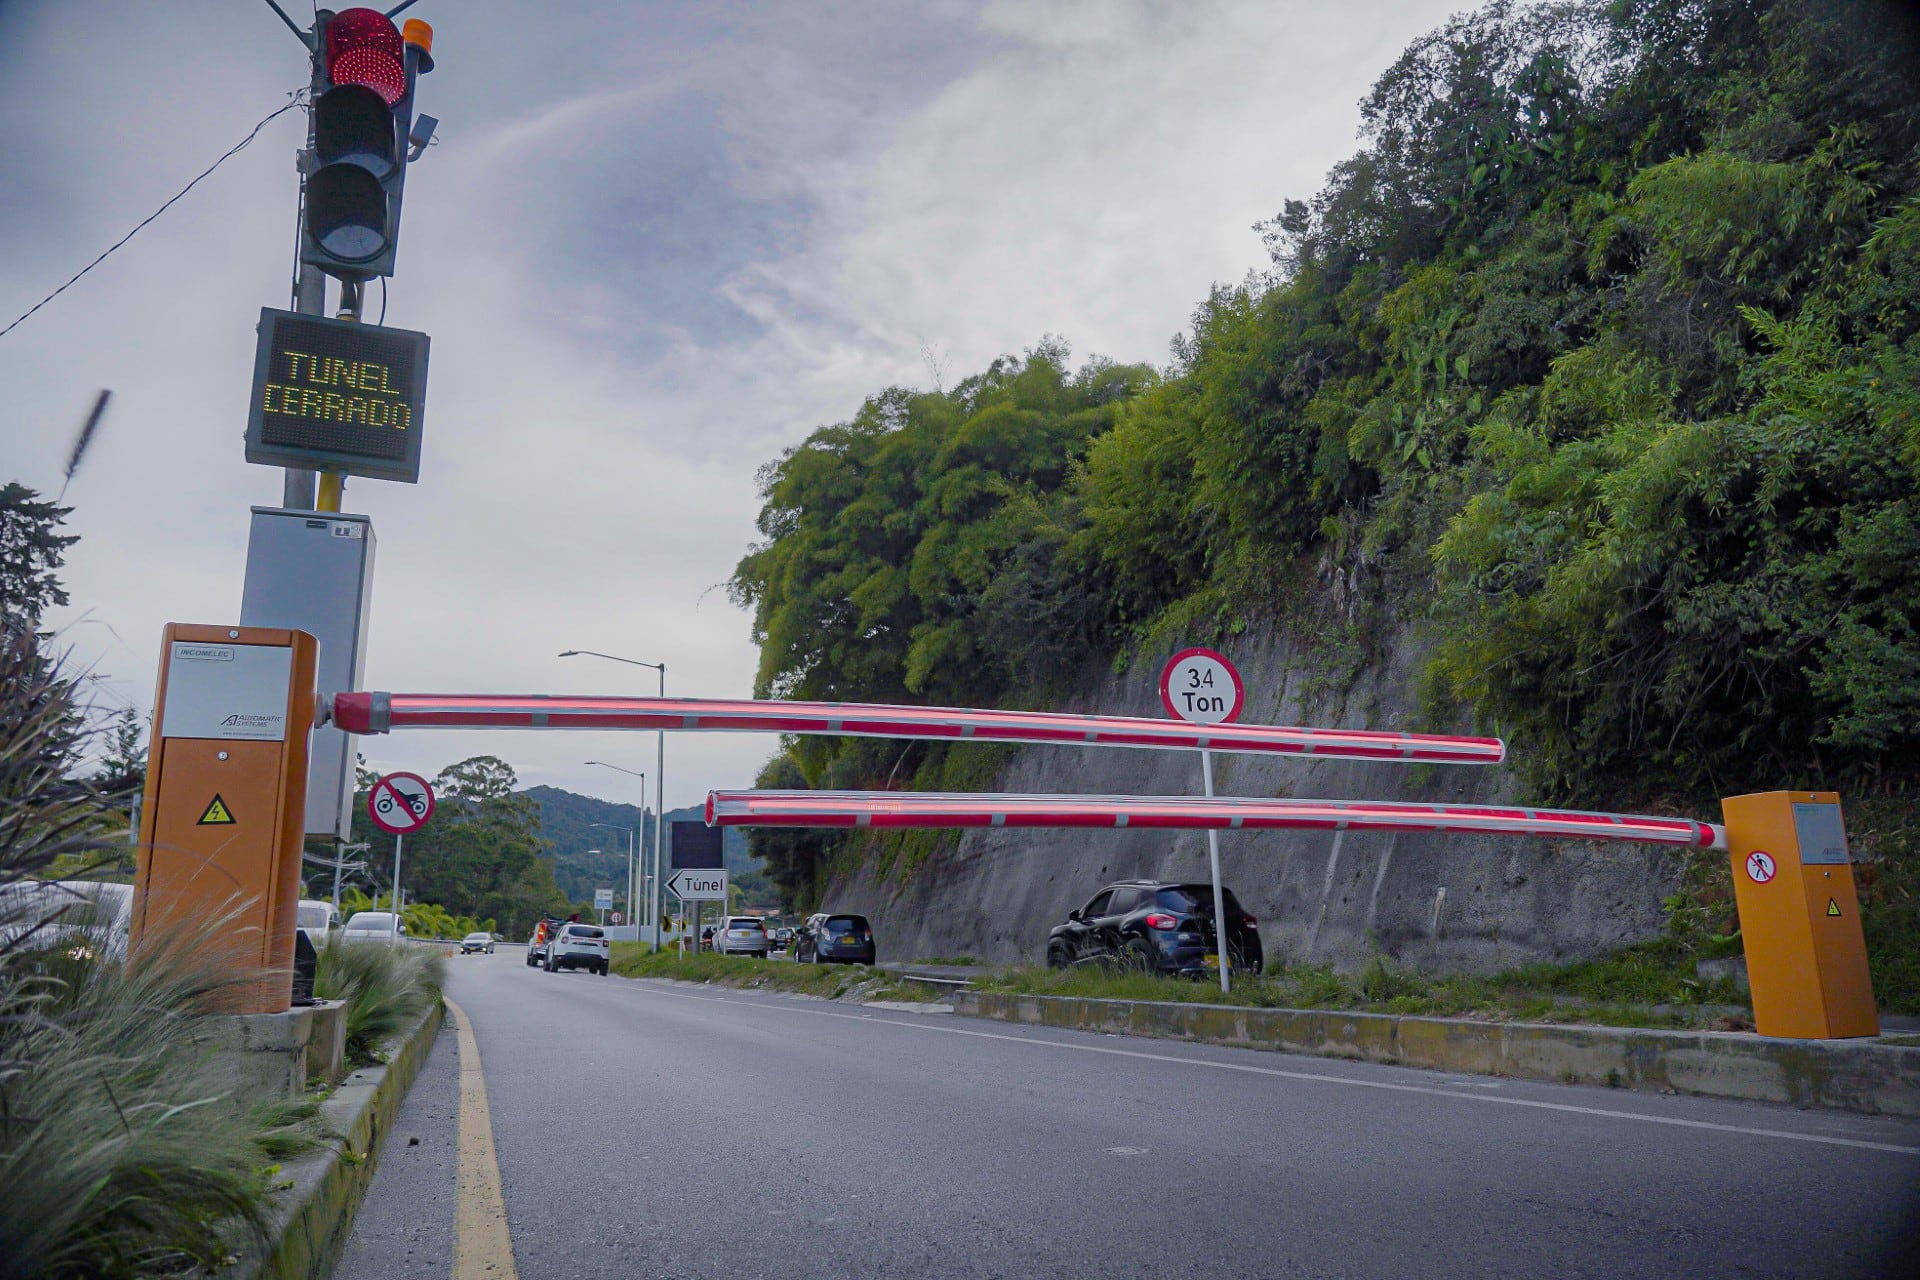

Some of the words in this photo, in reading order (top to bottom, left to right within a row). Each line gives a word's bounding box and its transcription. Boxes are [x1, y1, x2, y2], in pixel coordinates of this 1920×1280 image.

[283, 351, 400, 395] TUNEL
[263, 383, 412, 430] CERRADO
[180, 648, 230, 658] INCOMELEC
[1187, 667, 1214, 689] 3.4
[1182, 692, 1224, 712] Ton
[684, 877, 723, 891] Túnel
